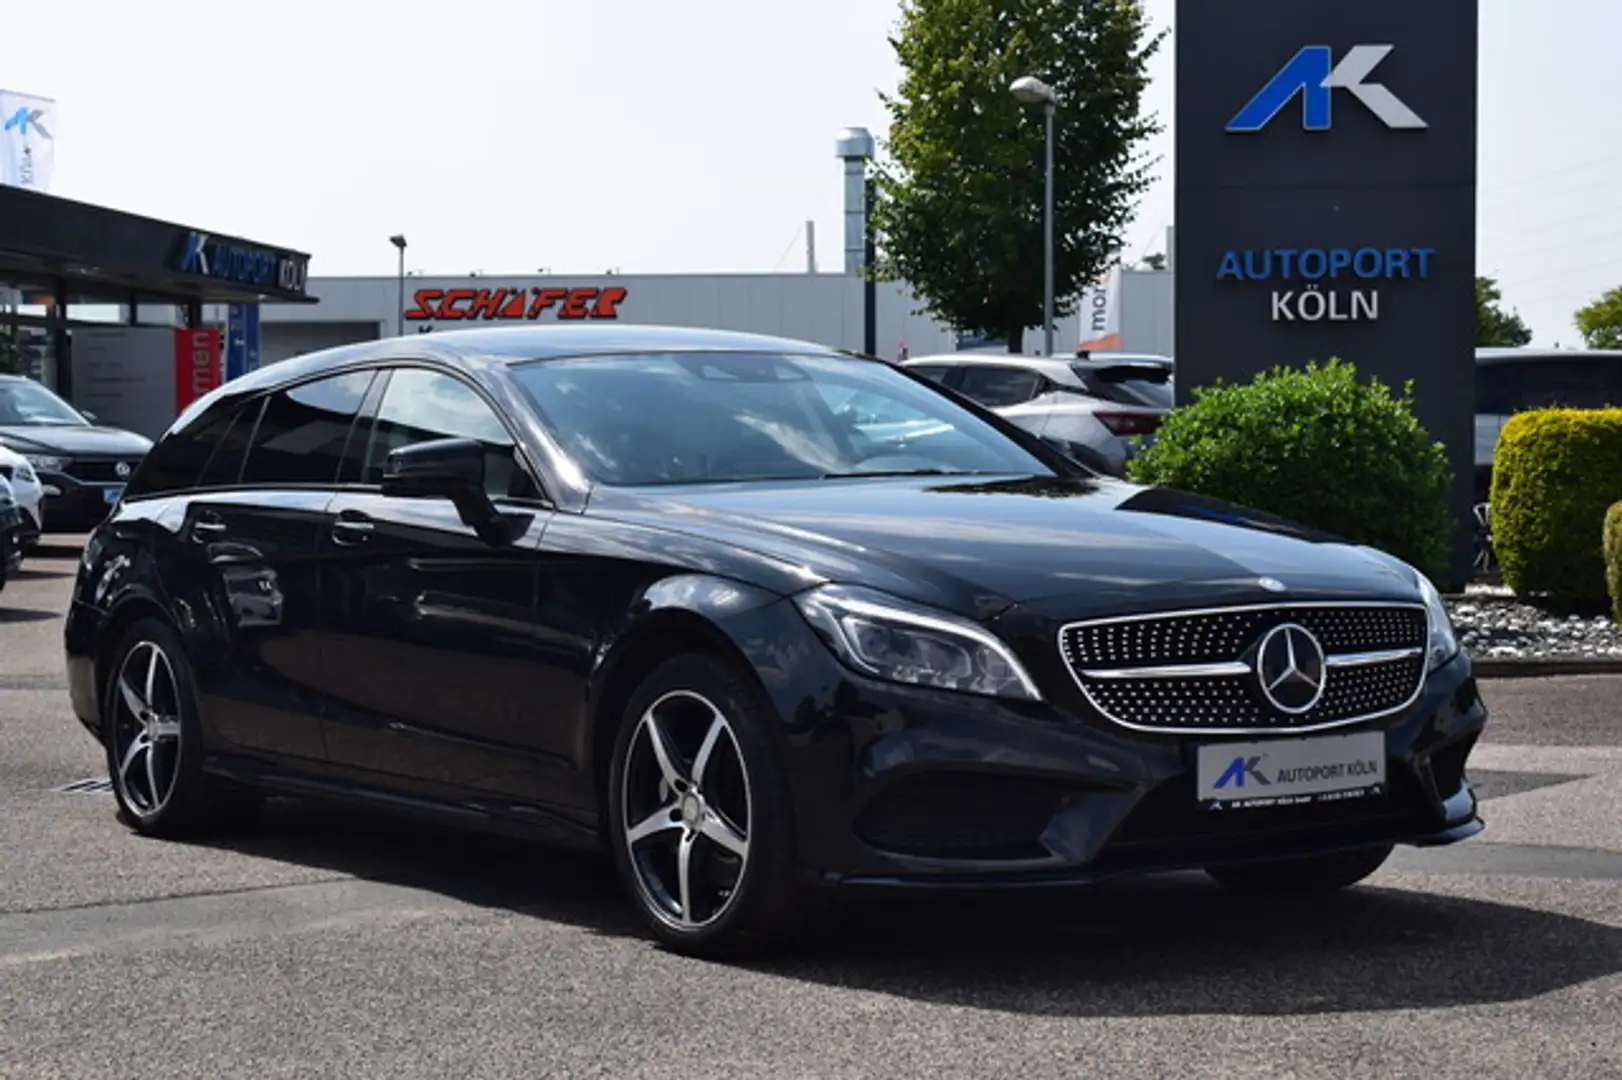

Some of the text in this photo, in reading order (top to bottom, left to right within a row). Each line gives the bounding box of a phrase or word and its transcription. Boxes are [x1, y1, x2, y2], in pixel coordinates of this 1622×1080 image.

[1224, 44, 1430, 131] AK
[1216, 247, 1435, 280] AUTOPORT
[404, 287, 627, 320] SCHÄFER
[1272, 284, 1379, 321] KÖLN
[192, 332, 210, 397] men
[1276, 763, 1345, 783] AUTOPORT
[1347, 760, 1378, 777] KÖLN
